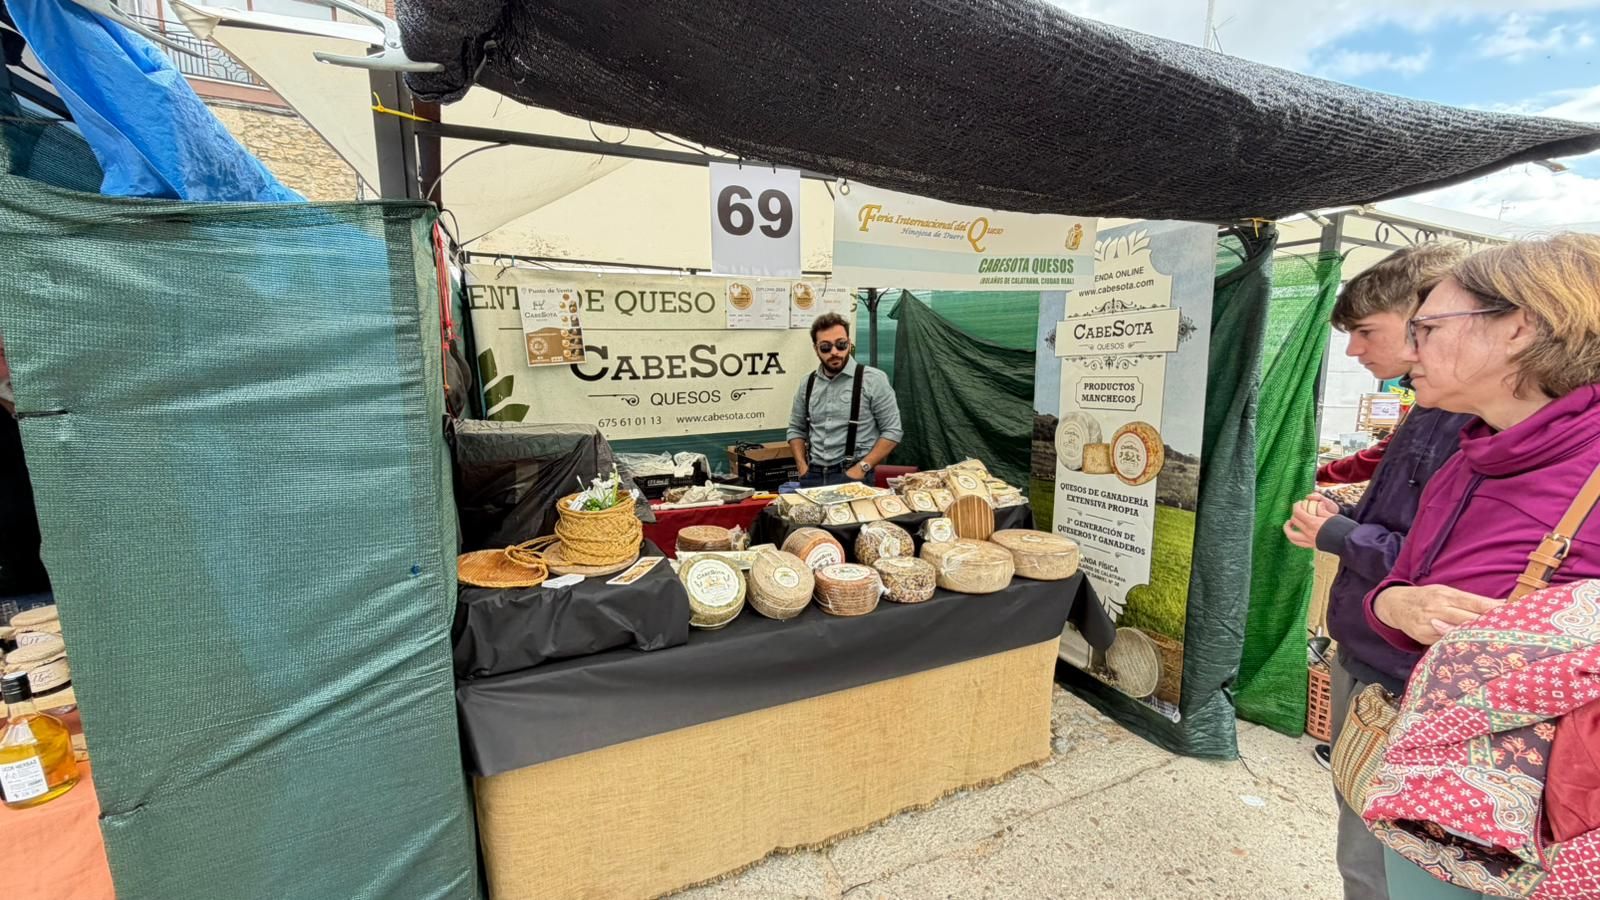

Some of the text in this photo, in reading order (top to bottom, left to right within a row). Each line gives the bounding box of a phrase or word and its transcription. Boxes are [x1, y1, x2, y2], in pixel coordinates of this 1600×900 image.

[717, 184, 793, 238] 69
[858, 204, 1004, 253] Feria Internacional del Queso
[900, 227, 964, 241] Hinojosa de Duero
[978, 257, 1074, 274] CABESOTA QUESOS
[1115, 266, 1145, 279] ONLINE
[1003, 277, 1011, 285] DE
[1078, 278, 1154, 298] www.cabesota.com
[576, 288, 605, 312] E
[614, 289, 716, 316] QUESO
[1096, 342, 1125, 351] QUESOS
[1083, 382, 1135, 392] PRODUCTOS
[650, 389, 722, 407] QUESOS
[1081, 394, 1137, 404] MANCHEGOS
[598, 410, 765, 428] 675 61 01 13 www.cabesota.com
[1059, 482, 1149, 508] QUESOS DE GANADERÍA
[1066, 494, 1139, 517] EXTENSIVA PROPIA
[1073, 518, 1123, 539] GENERACIÓN
[1123, 532, 1136, 542] DE
[1057, 524, 1146, 556] QUESEROS Y GANADEROS
[1098, 559, 1119, 574] FÍSICA
